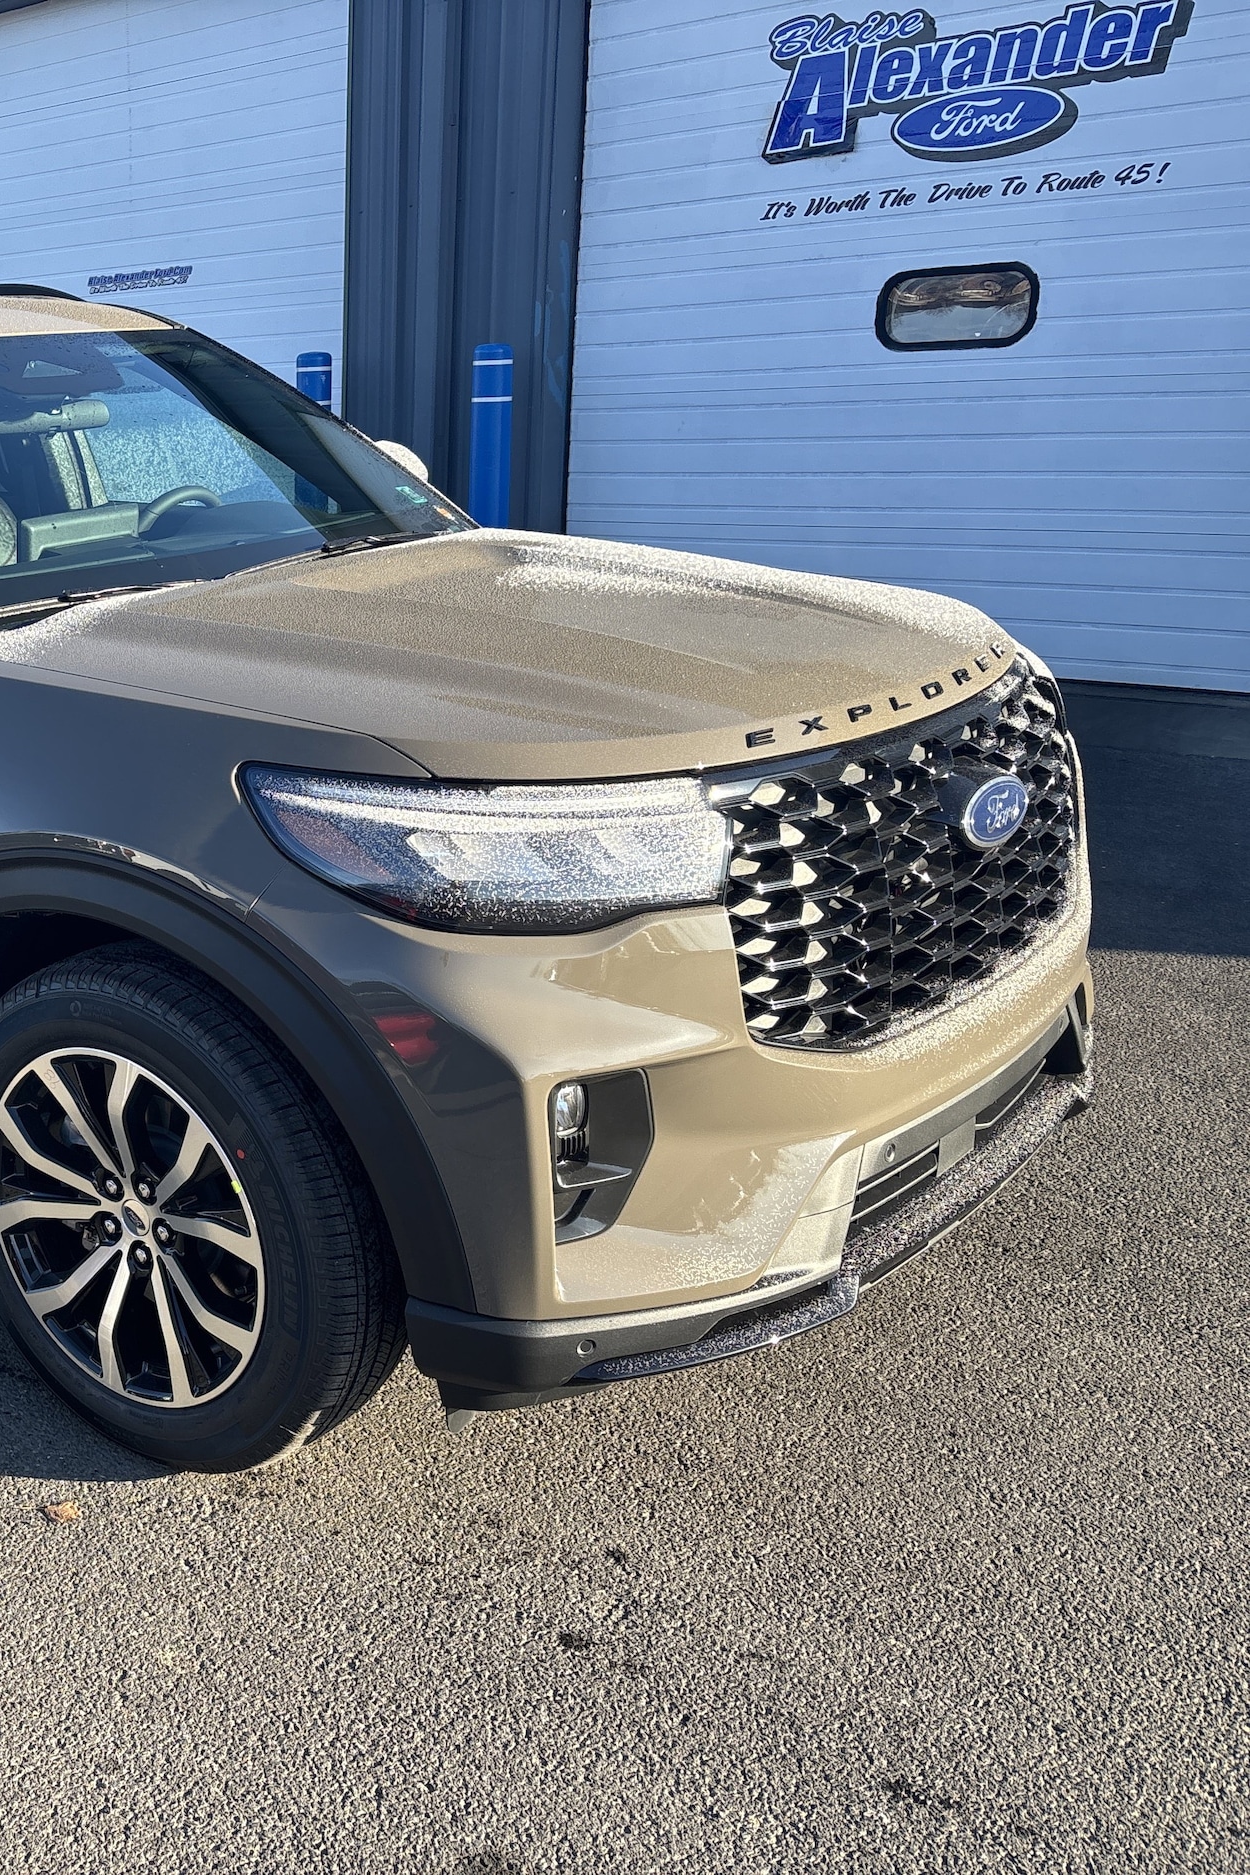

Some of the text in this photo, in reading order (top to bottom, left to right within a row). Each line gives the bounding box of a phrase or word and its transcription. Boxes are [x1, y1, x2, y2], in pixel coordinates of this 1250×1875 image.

[772, 12, 925, 60] Blaise
[767, 0, 1180, 154] Alexander
[929, 97, 1026, 141] Ford
[759, 201, 798, 221] It's
[803, 191, 871, 217] Worth
[878, 187, 917, 209] The
[927, 182, 993, 204] Drive
[1000, 176, 1028, 196] To
[1035, 170, 1106, 193] Route
[745, 640, 1006, 749] EXPLORER
[986, 789, 1020, 834] Ford
[260, 1185, 299, 1332] MICHELIN
